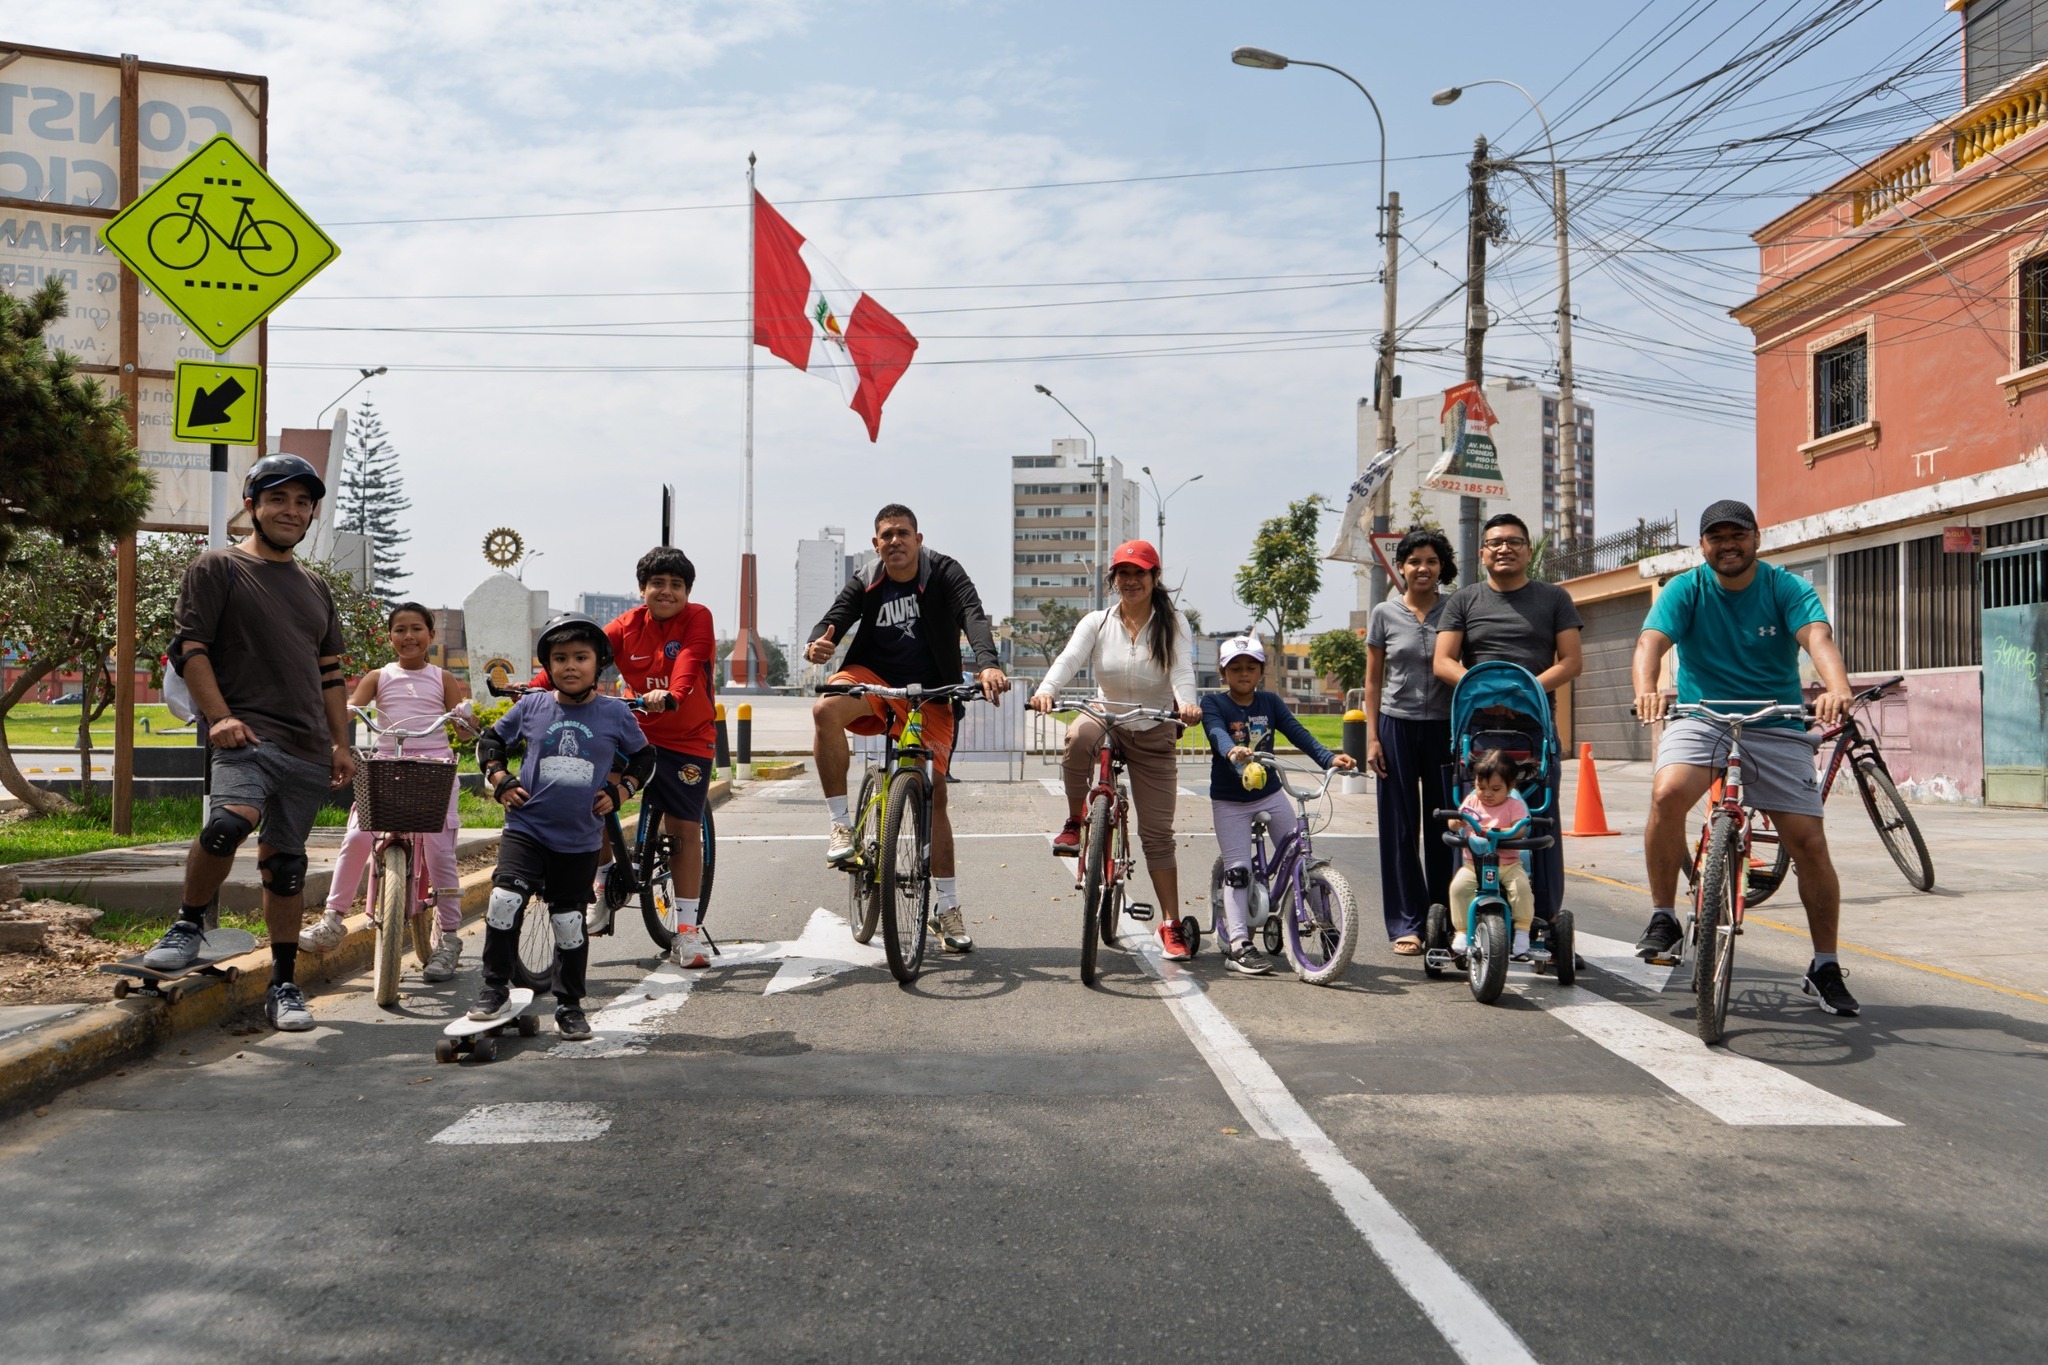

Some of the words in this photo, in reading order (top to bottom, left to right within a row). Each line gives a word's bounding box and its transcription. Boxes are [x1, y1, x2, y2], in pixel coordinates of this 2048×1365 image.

[1466, 449, 1494, 457] CORNEJO
[1476, 456, 1490, 464] PISO
[1466, 462, 1490, 470] PUEBLO
[1442, 480, 1461, 490] 922
[1464, 483, 1482, 492] 185
[1486, 485, 1504, 495] 571
